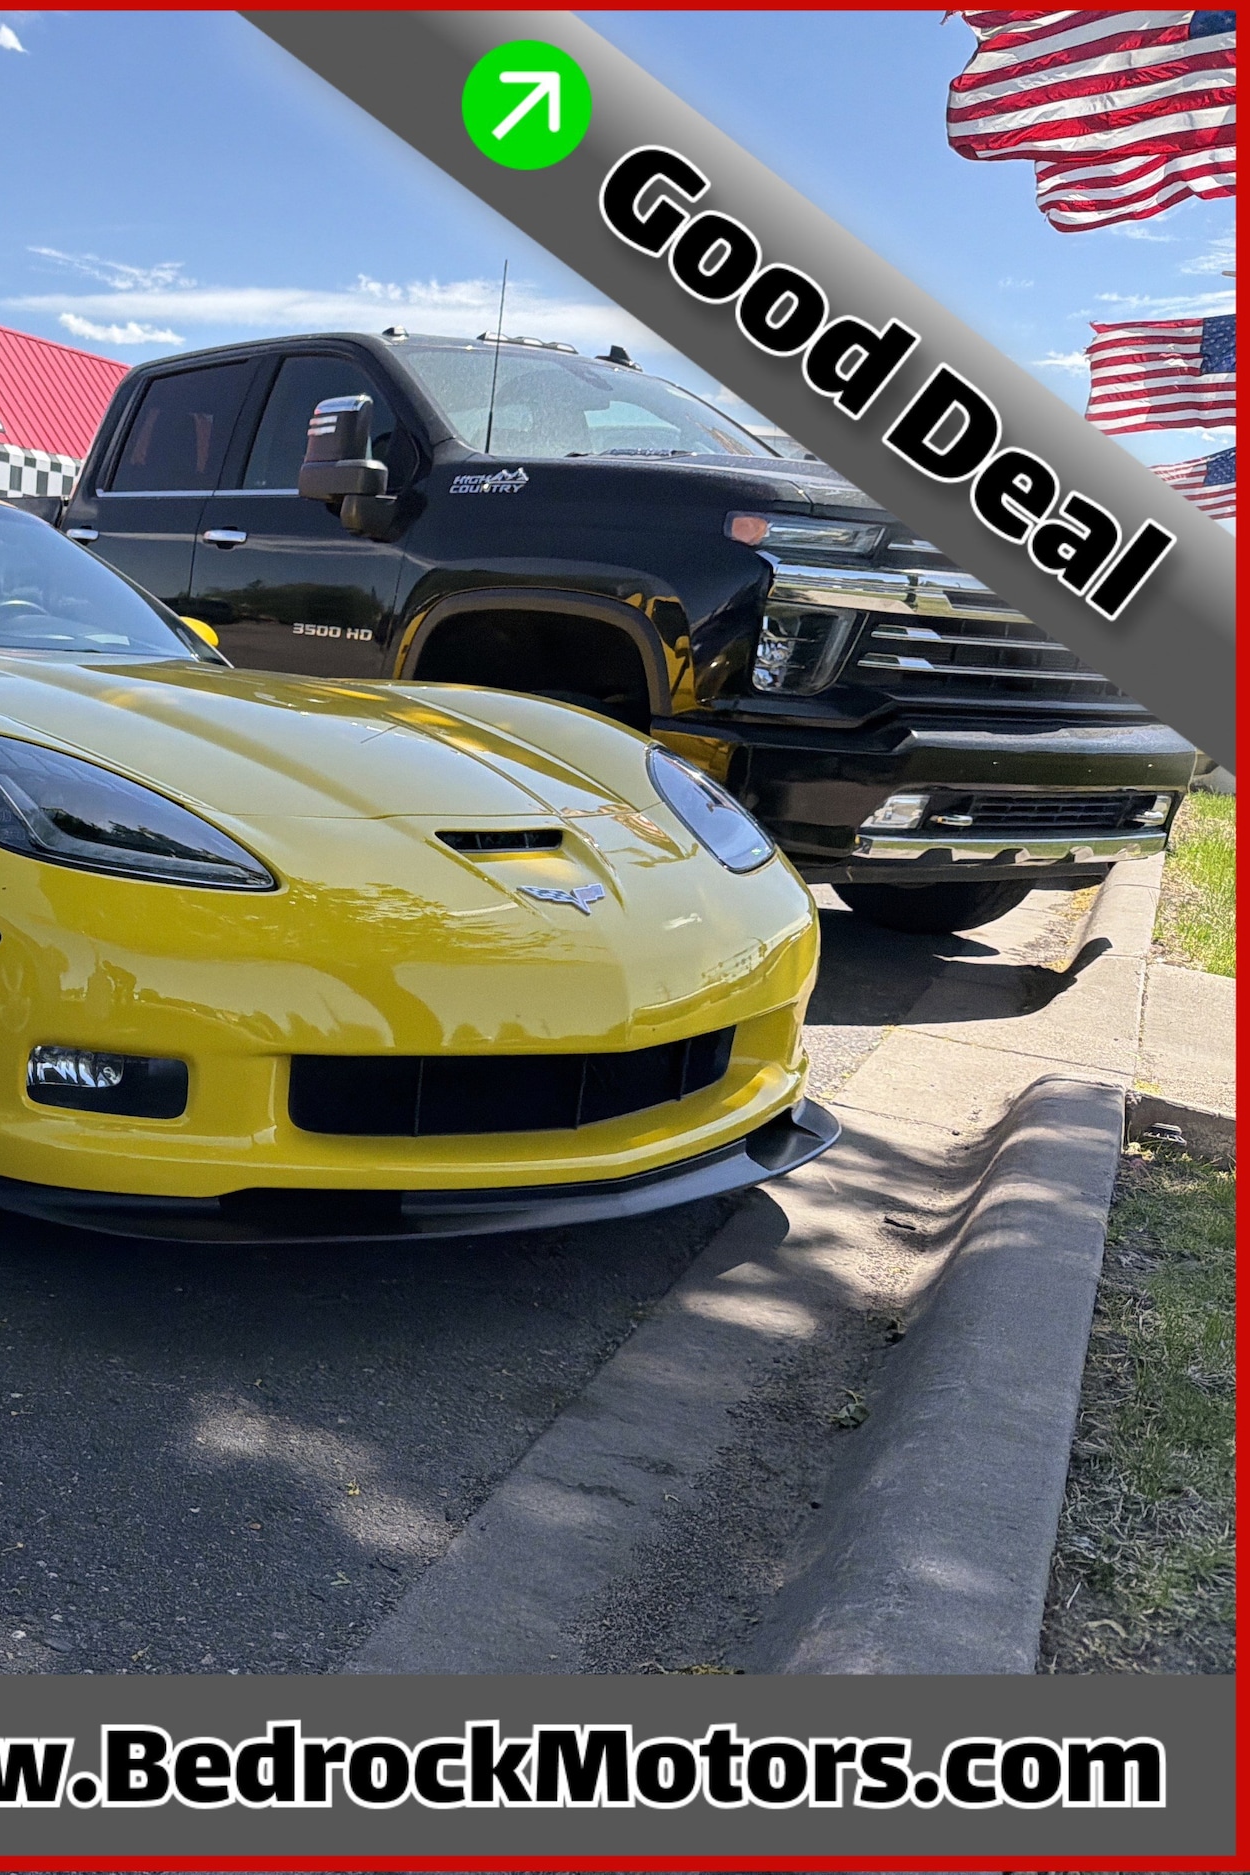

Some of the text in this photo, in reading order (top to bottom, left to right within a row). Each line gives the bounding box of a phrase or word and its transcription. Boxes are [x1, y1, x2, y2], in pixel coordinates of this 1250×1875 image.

[453, 474, 492, 485] HIGH
[449, 484, 525, 494] COUNTRY
[292, 622, 373, 641] 3500 HD
